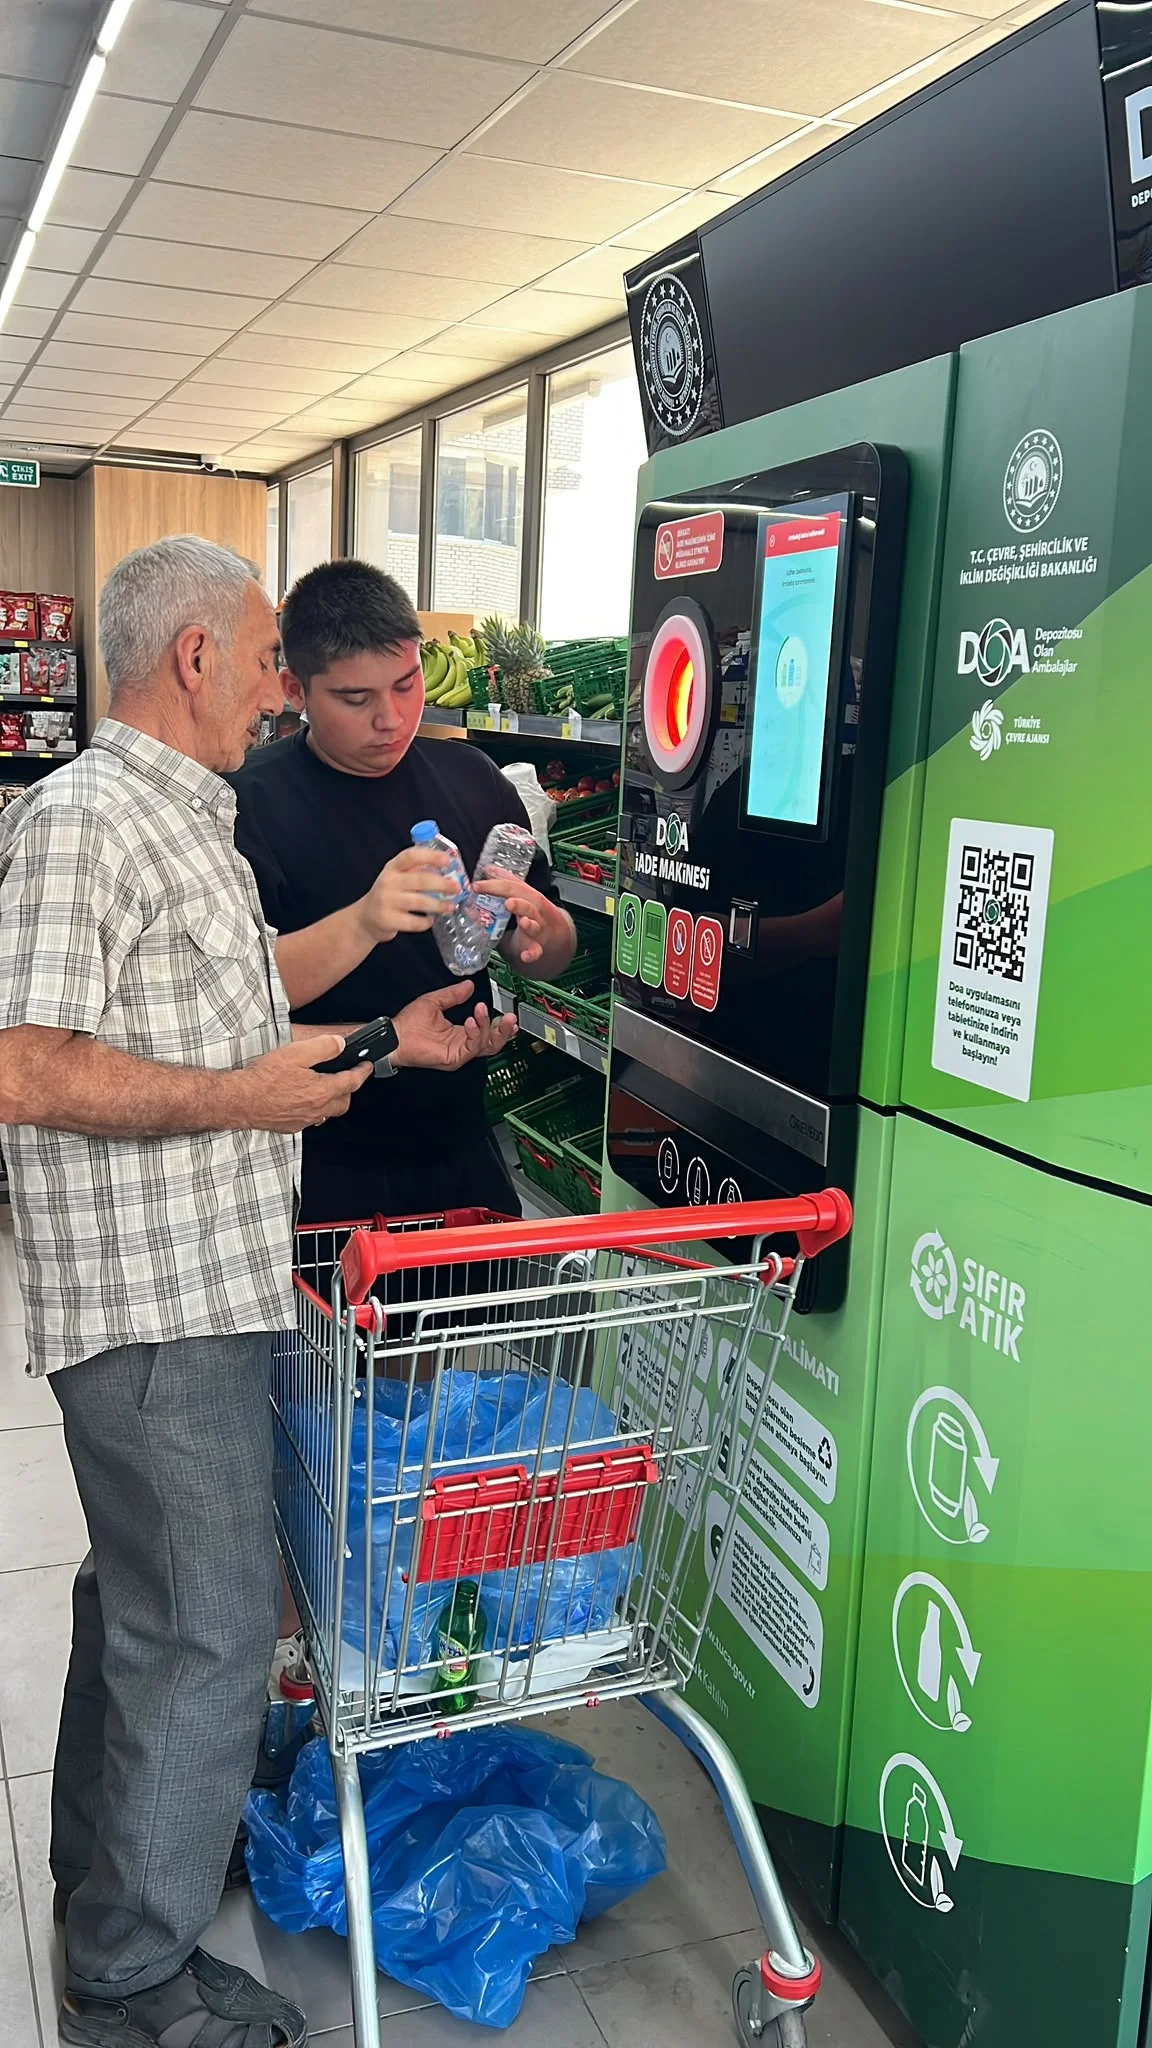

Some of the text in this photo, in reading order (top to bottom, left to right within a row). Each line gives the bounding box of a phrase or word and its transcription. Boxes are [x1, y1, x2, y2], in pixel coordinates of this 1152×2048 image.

[12, 473, 33, 481] EXIT
[970, 536, 1089, 565] T.C. ÇEVRE, ŞEHİRCİLİK VE
[960, 556, 1097, 585] İKLİM DEĞİŞİKLİĞİ BAKANLIĞI
[1035, 627, 1083, 643] Depozitosu
[957, 618, 1030, 686] DOA
[1033, 644, 1054, 658] Olan
[1031, 659, 1078, 677] Ambalajlar
[1014, 715, 1041, 729] TÜRKİYE
[1005, 732, 1050, 744] ÇEVRE AJANSI
[656, 812, 689, 856] DOA
[949, 981, 1020, 1010] Doa uygulamasını
[948, 996, 1021, 1027] telefonunuza veya
[948, 1011, 1019, 1041] tabletinize indirin
[953, 1028, 1010, 1055] ve kullanmaya
[962, 1044, 998, 1066] başlayın!
[962, 1257, 1026, 1322] SIFIR
[959, 1296, 1023, 1363] ATIK
[779, 1334, 839, 1396] ALİMATI
[747, 1373, 779, 1411] Depoosu
[780, 1405, 794, 1424] olan
[745, 1398, 828, 1487] hazsine atmaya başlayın.
[789, 1427, 817, 1460] besleme
[756, 1476, 780, 1506] depozito
